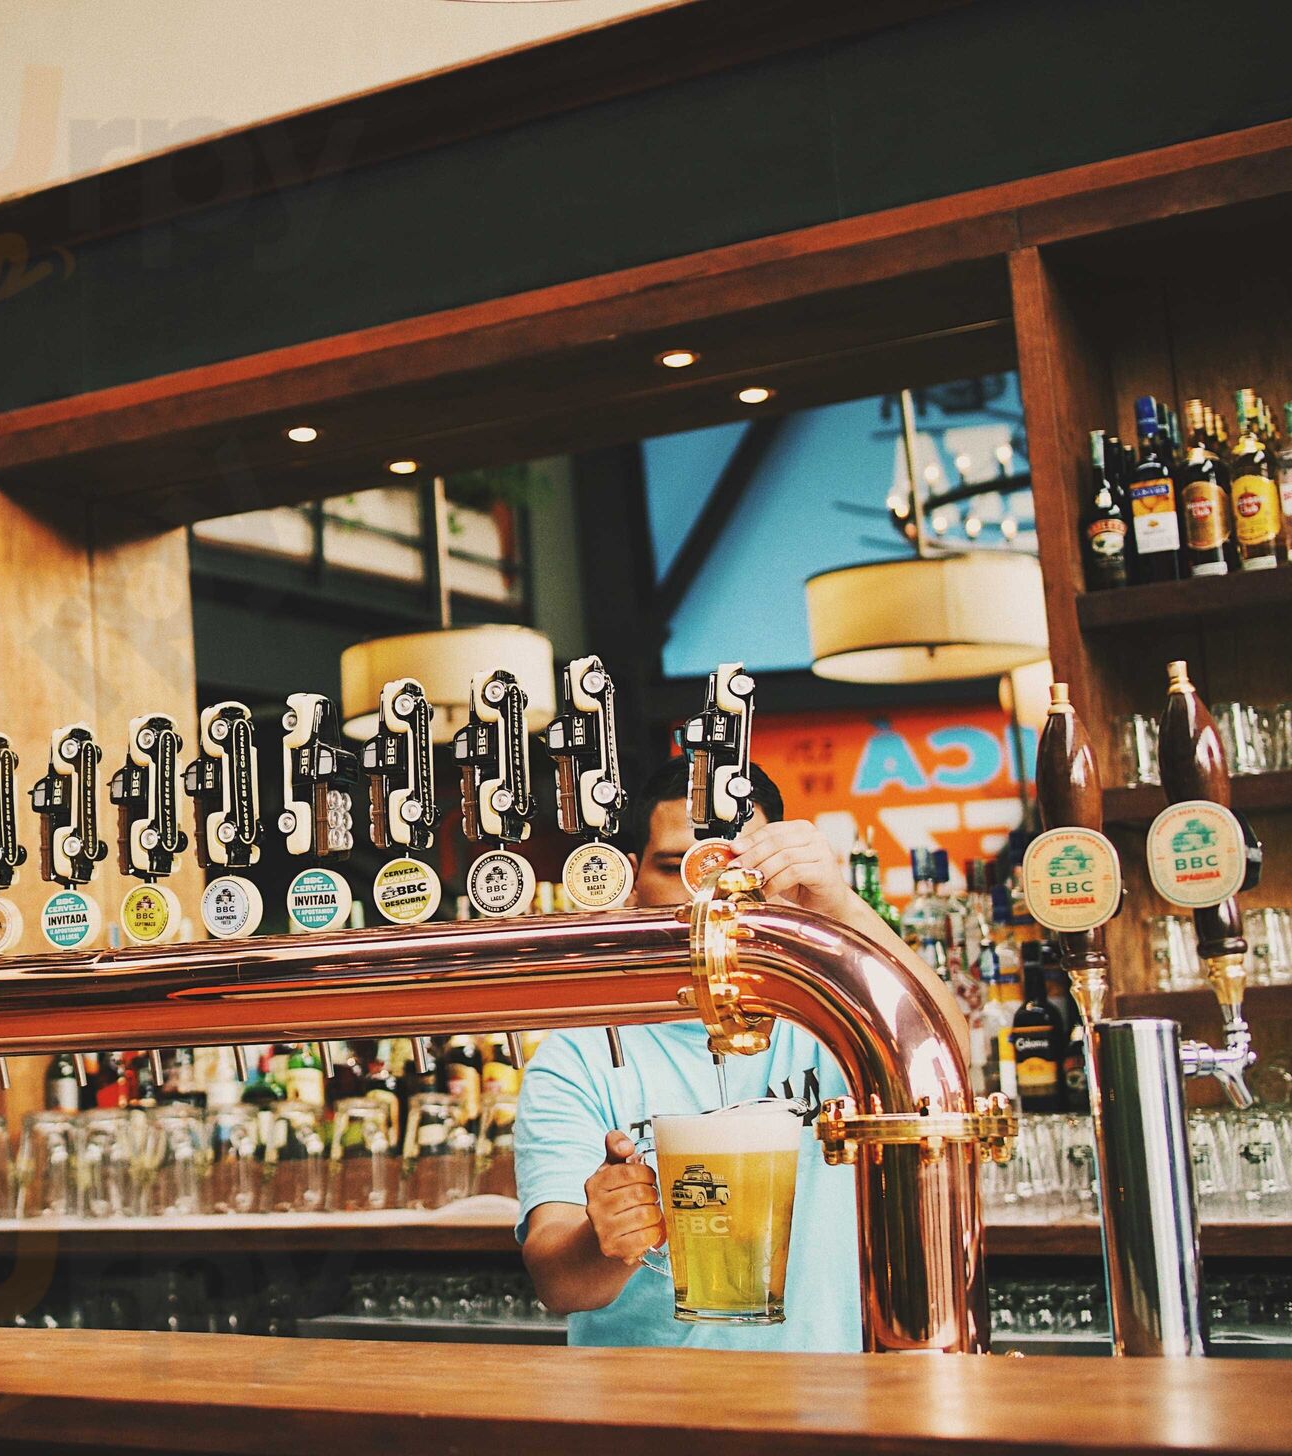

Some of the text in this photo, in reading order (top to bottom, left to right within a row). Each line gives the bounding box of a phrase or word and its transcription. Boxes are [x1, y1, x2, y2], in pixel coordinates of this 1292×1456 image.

[574, 717, 583, 745] BBC
[714, 715, 725, 741] BBC
[478, 727, 486, 755] BBC
[387, 736, 395, 764] BBC
[132, 770, 140, 796] BBC
[53, 779, 62, 805] BBC
[1175, 855, 1218, 870] BBC
[384, 867, 419, 877] CERVEZA
[303, 876, 323, 884] BBC
[583, 874, 607, 883] BBC
[295, 883, 334, 892] CERVEZA
[397, 883, 427, 896] BBC
[486, 884, 507, 893] BBC
[1050, 881, 1094, 894] BBC
[56, 897, 75, 905] BBC
[295, 894, 336, 906] INVITADA
[385, 896, 426, 907] DESCUBRA
[48, 904, 86, 913] CERVEZA
[48, 914, 88, 926] INVITADA
[675, 1214, 730, 1234] BBC
